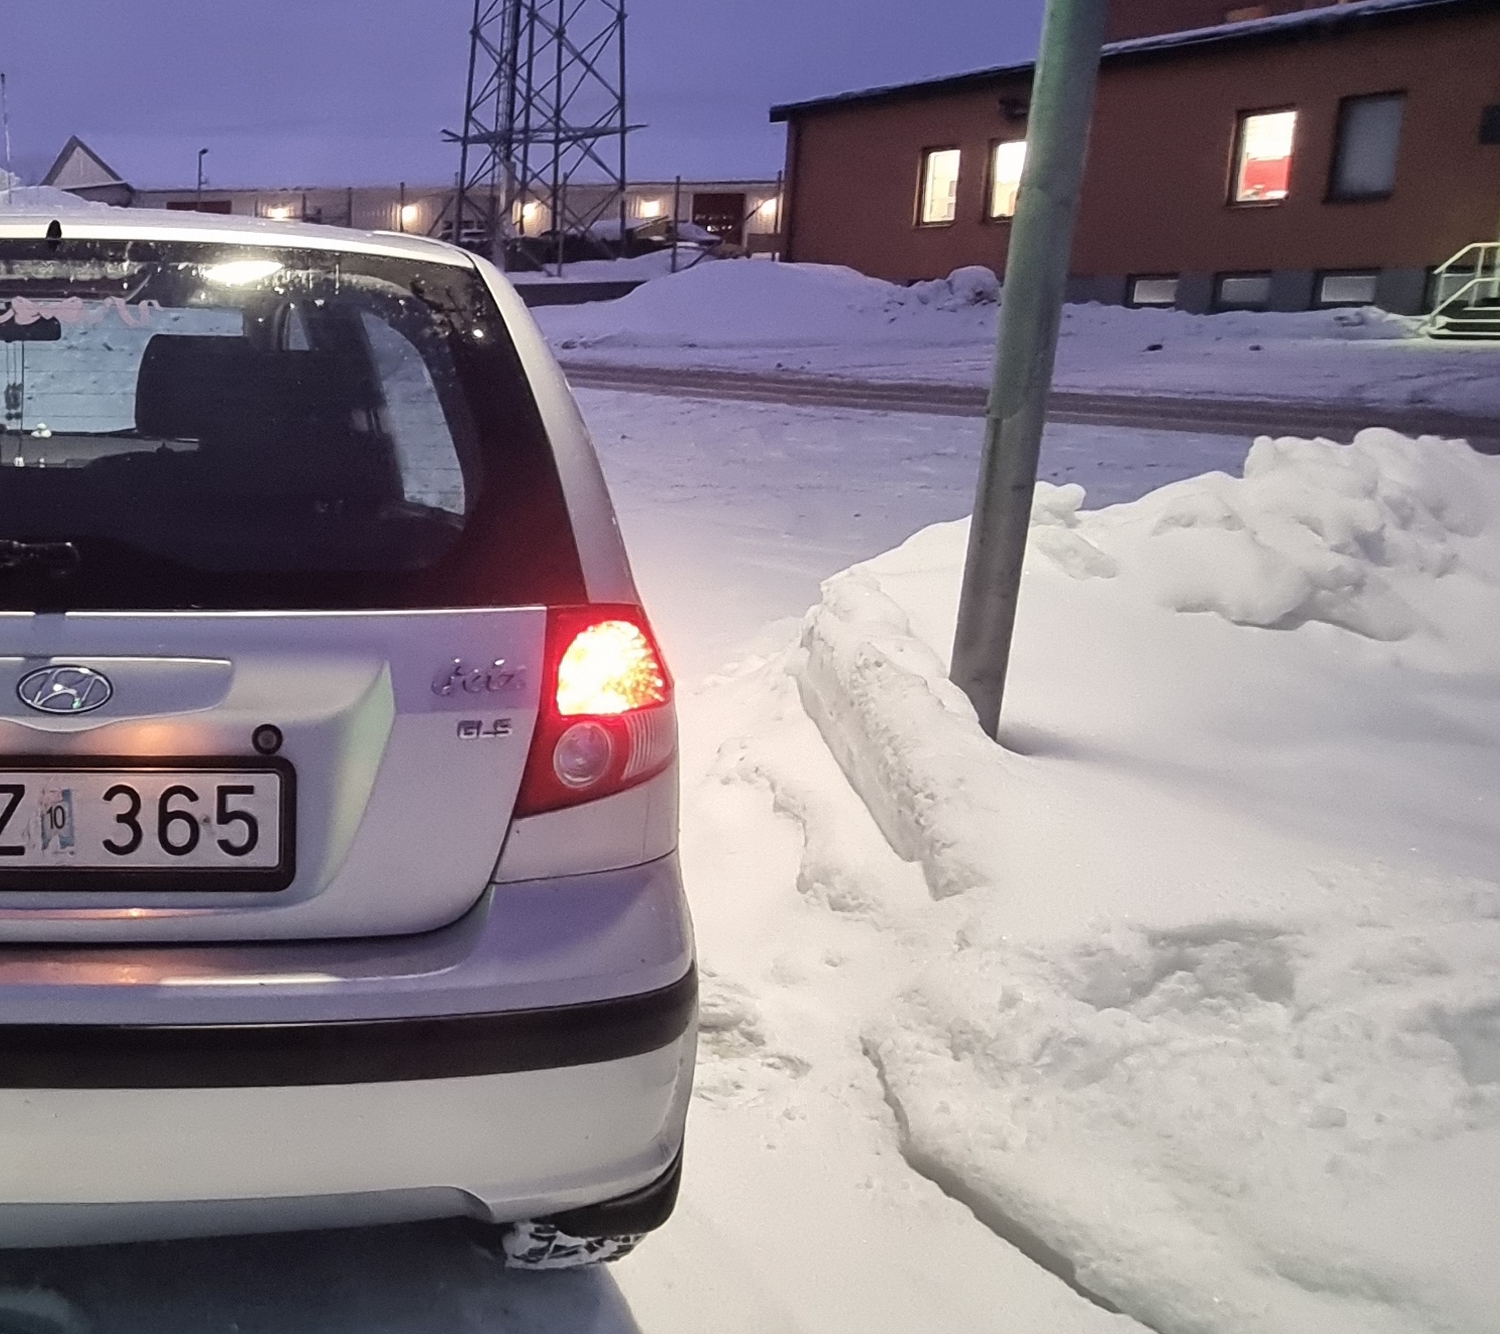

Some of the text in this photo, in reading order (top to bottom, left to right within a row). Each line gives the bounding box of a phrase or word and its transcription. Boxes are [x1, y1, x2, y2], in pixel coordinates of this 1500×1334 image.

[456, 718, 512, 740] GLS
[45, 804, 66, 830] 10
[101, 783, 260, 857] 365
